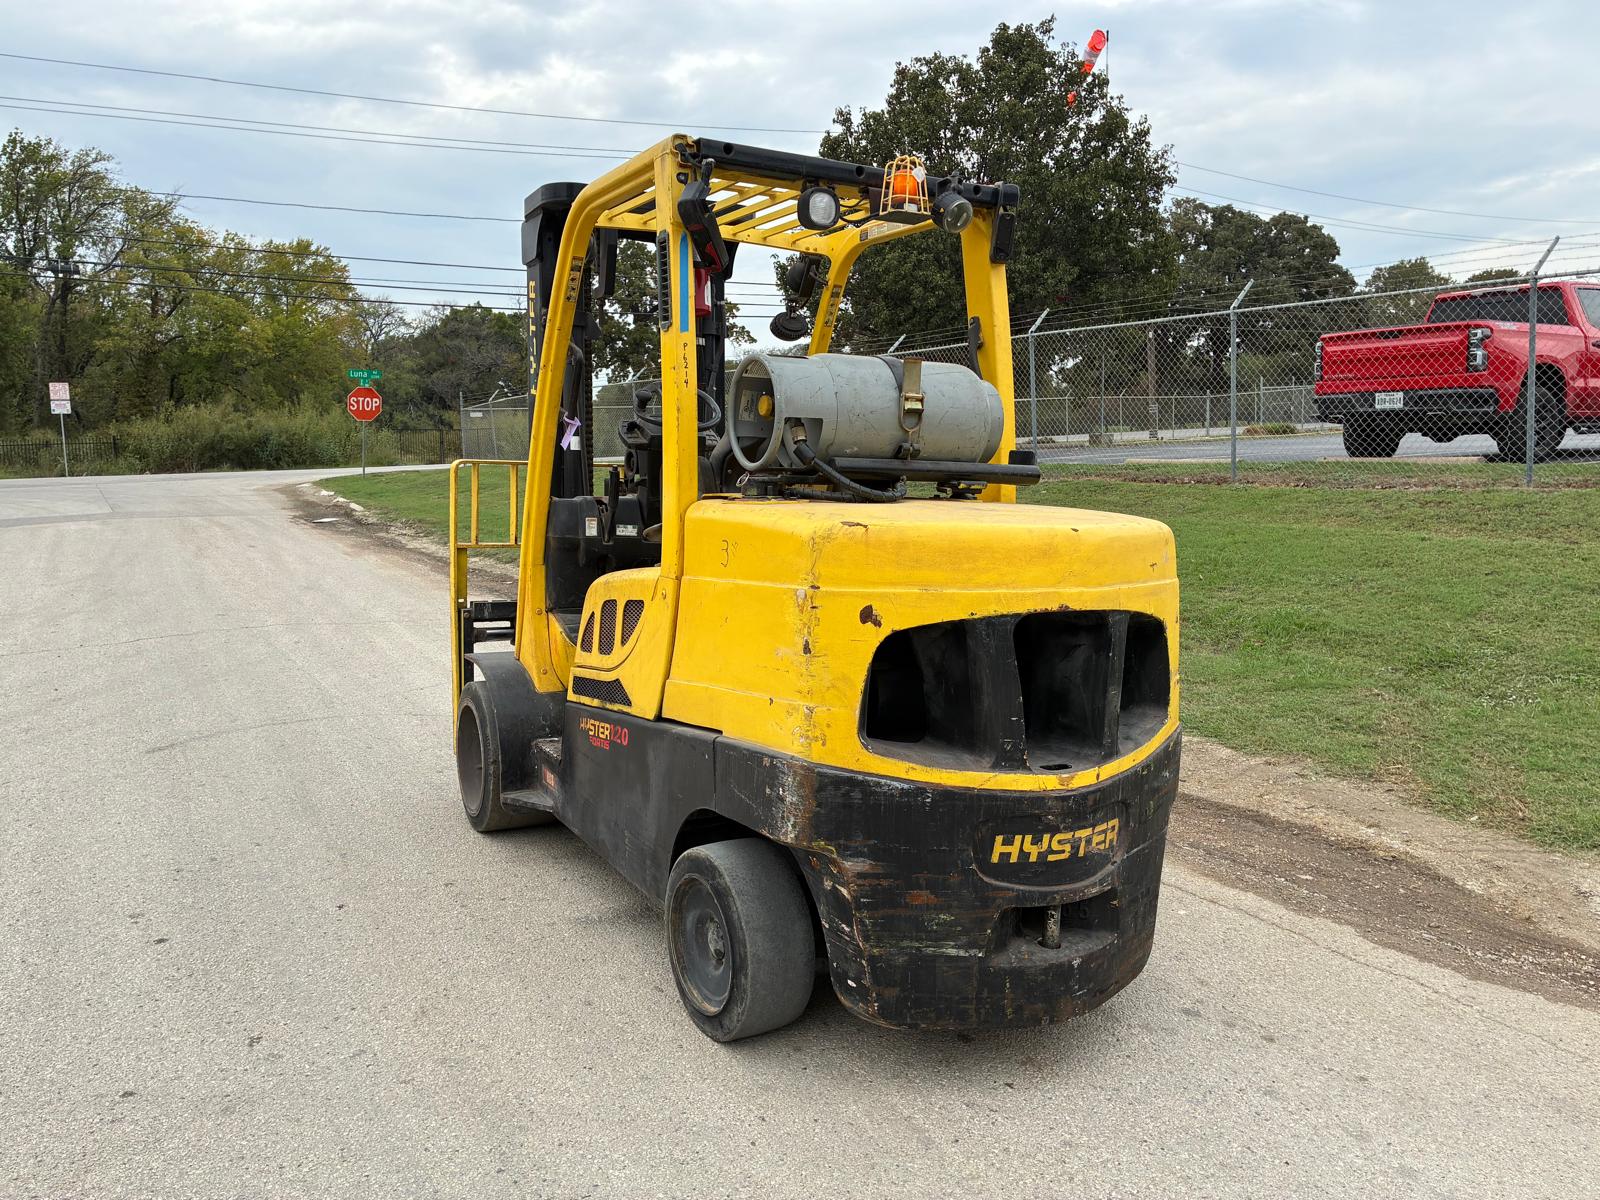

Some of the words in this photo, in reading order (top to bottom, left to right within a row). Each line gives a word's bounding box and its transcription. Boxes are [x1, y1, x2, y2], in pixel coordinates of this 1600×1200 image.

[350, 397, 380, 411] STOP
[610, 723, 629, 746] 120
[991, 818, 1119, 863] HYSTER
